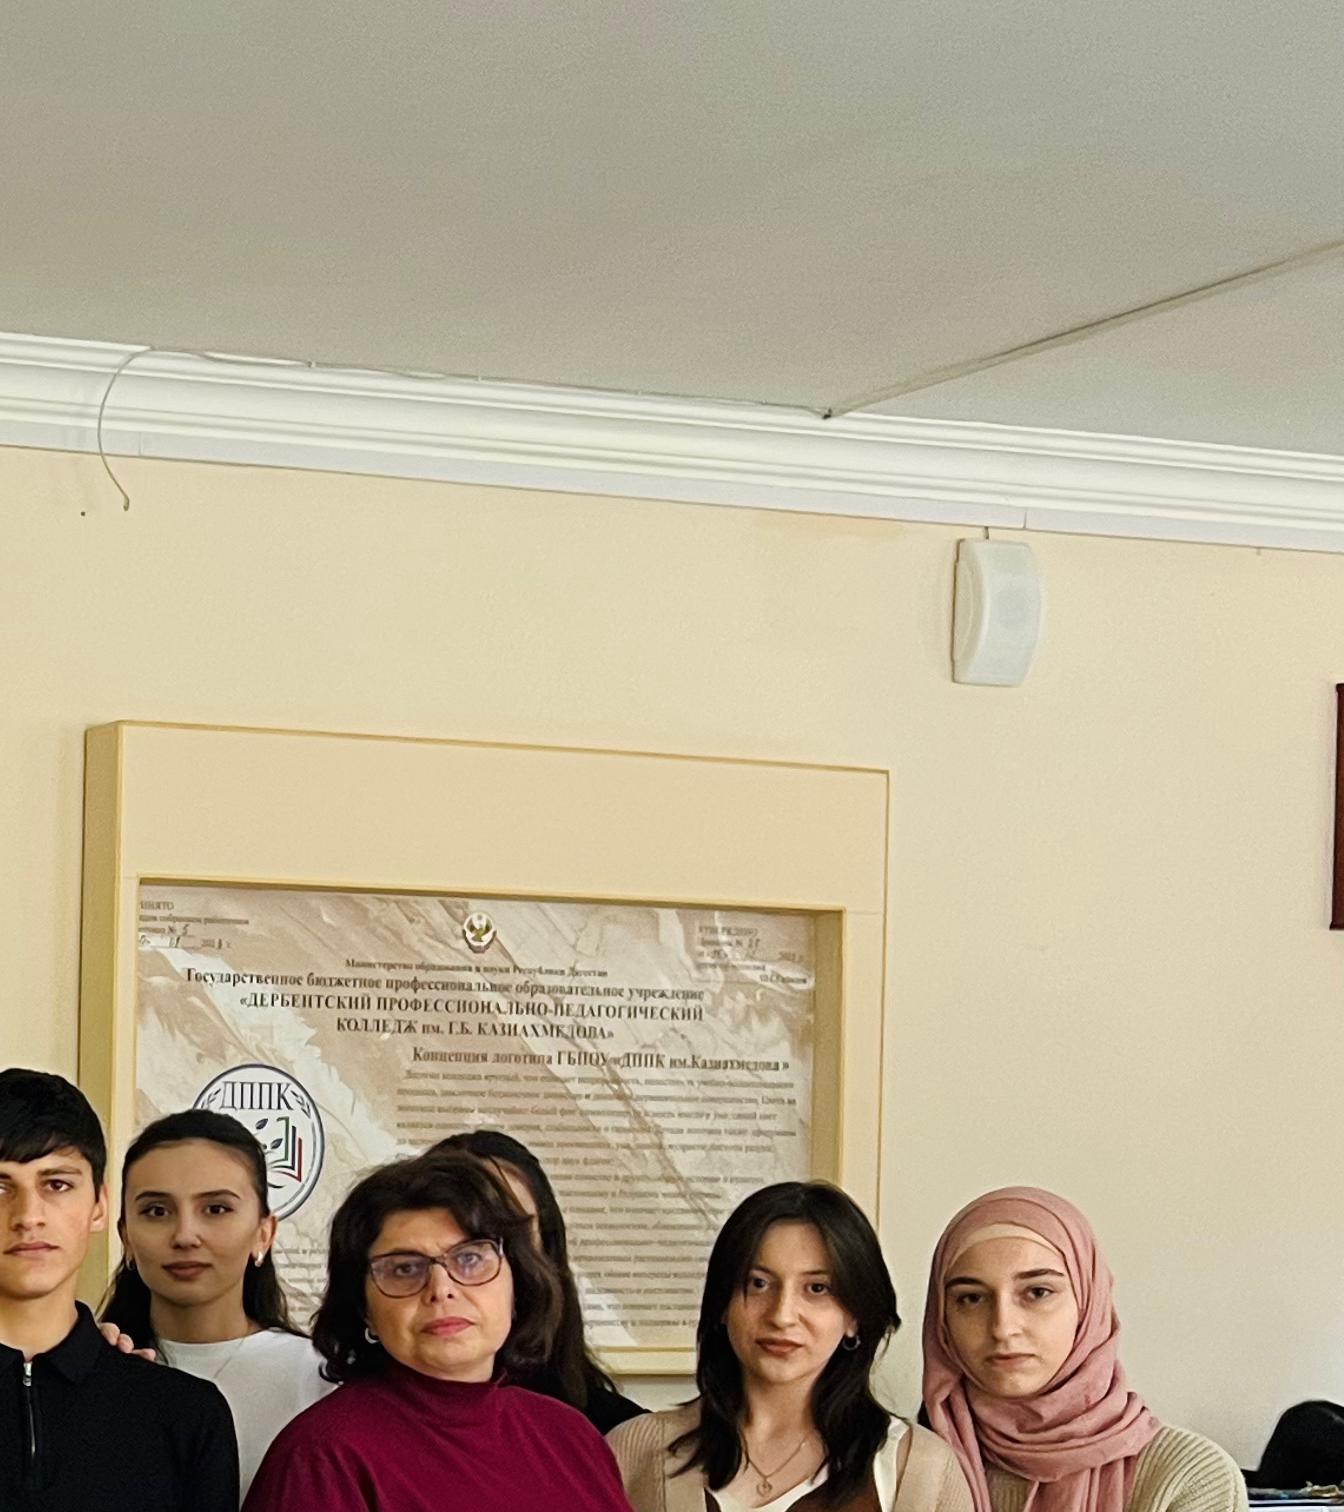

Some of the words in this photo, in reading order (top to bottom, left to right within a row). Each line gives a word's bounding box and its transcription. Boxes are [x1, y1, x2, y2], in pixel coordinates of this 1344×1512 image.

[186, 967, 302, 987] Государственное
[307, 971, 380, 990] бюджетное
[386, 975, 512, 995] профессиональное
[239, 991, 371, 1010] «ДЕРБЕНТСКИЙ
[337, 1017, 417, 1036] КОЛЛЕДЖ
[413, 1047, 488, 1065] Концепция
[218, 1081, 294, 1113] ДППК
